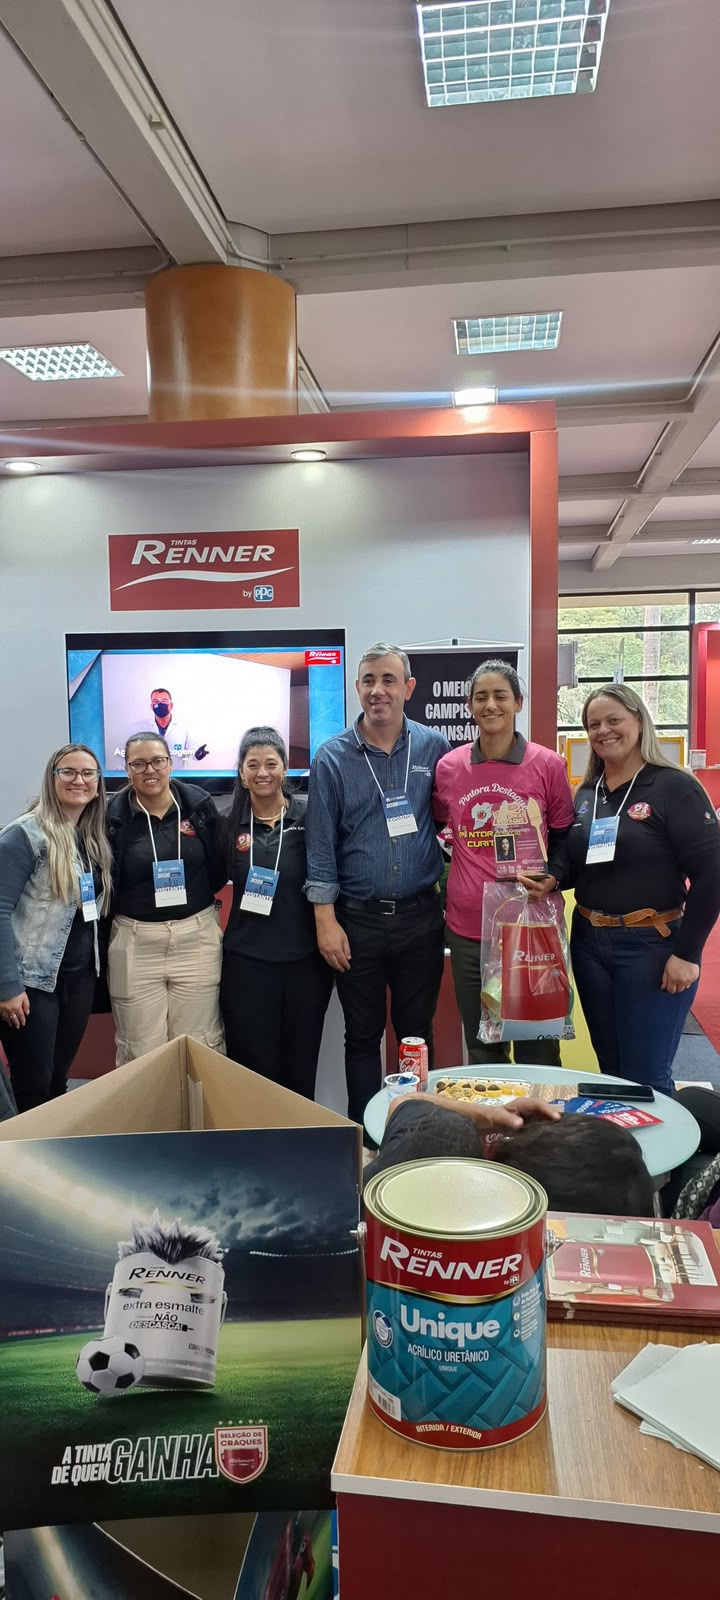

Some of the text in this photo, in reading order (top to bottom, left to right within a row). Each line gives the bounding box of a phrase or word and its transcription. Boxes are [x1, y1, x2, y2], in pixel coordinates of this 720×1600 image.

[131, 540, 276, 565] RENNER
[243, 587, 273, 600] by PPG
[432, 681, 441, 697] O
[425, 703, 475, 719] CAMPIS
[458, 785, 490, 806] Pintora
[458, 830, 494, 838] PINTOR
[379, 1236, 522, 1280] RENNER
[413, 1247, 443, 1259] TINTAS
[128, 1267, 206, 1284] RENNER
[123, 1301, 204, 1315] extra esmalte
[154, 1311, 178, 1322] NÃO
[400, 1304, 501, 1347] Unique
[407, 1343, 489, 1363] ACRÍLICO URETÂNICO
[438, 1365, 458, 1373] UNIQUE
[220, 1431, 251, 1439] SELEÇÃO
[416, 1424, 445, 1433] INTERIOR
[450, 1424, 482, 1440] EXTERIOR
[220, 1438, 263, 1447] CRAQUES
[62, 1443, 112, 1465] A TINTA
[104, 1434, 220, 1485] GANHA
[51, 1463, 110, 1486] DE QUEM
